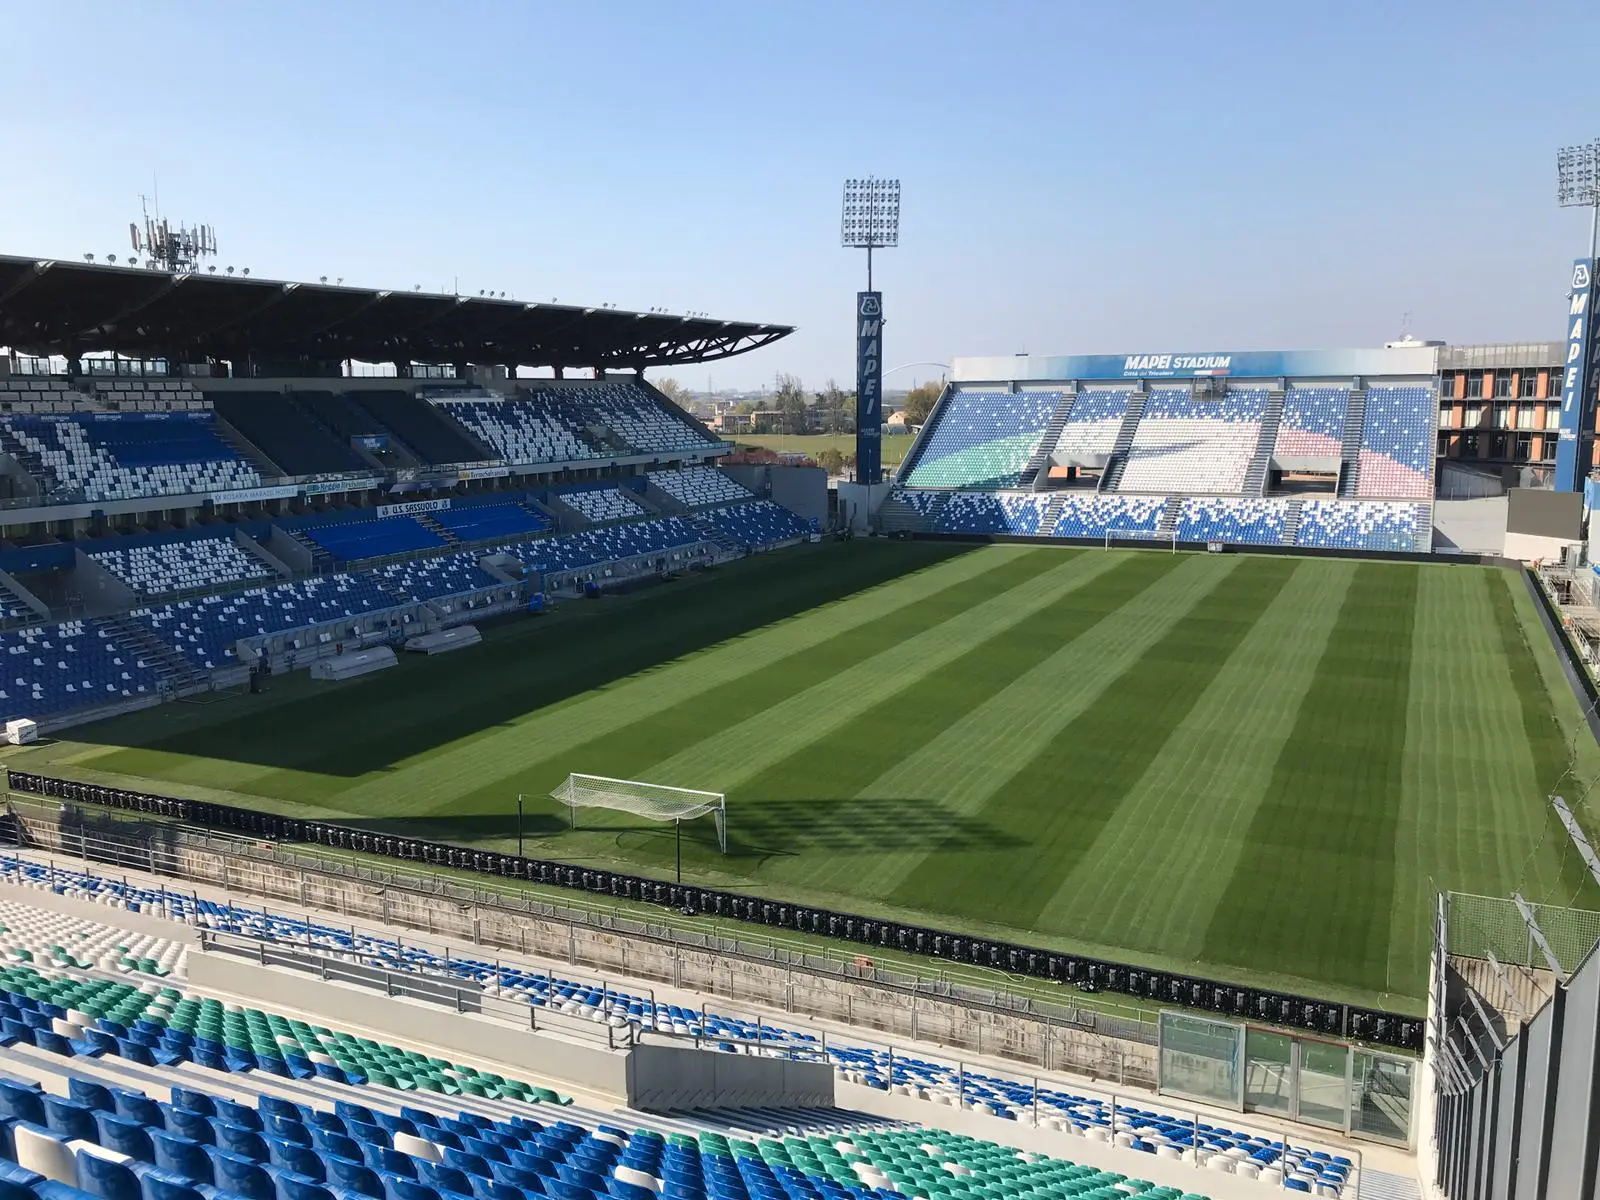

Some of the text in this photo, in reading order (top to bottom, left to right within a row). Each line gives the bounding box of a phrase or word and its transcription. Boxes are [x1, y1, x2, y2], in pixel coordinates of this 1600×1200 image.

[861, 320, 880, 415] MAPEI
[1124, 355, 1232, 370] MAPEI STADIUM
[1564, 293, 1588, 412] MAPEI
[405, 501, 438, 512] SASSUOLO
